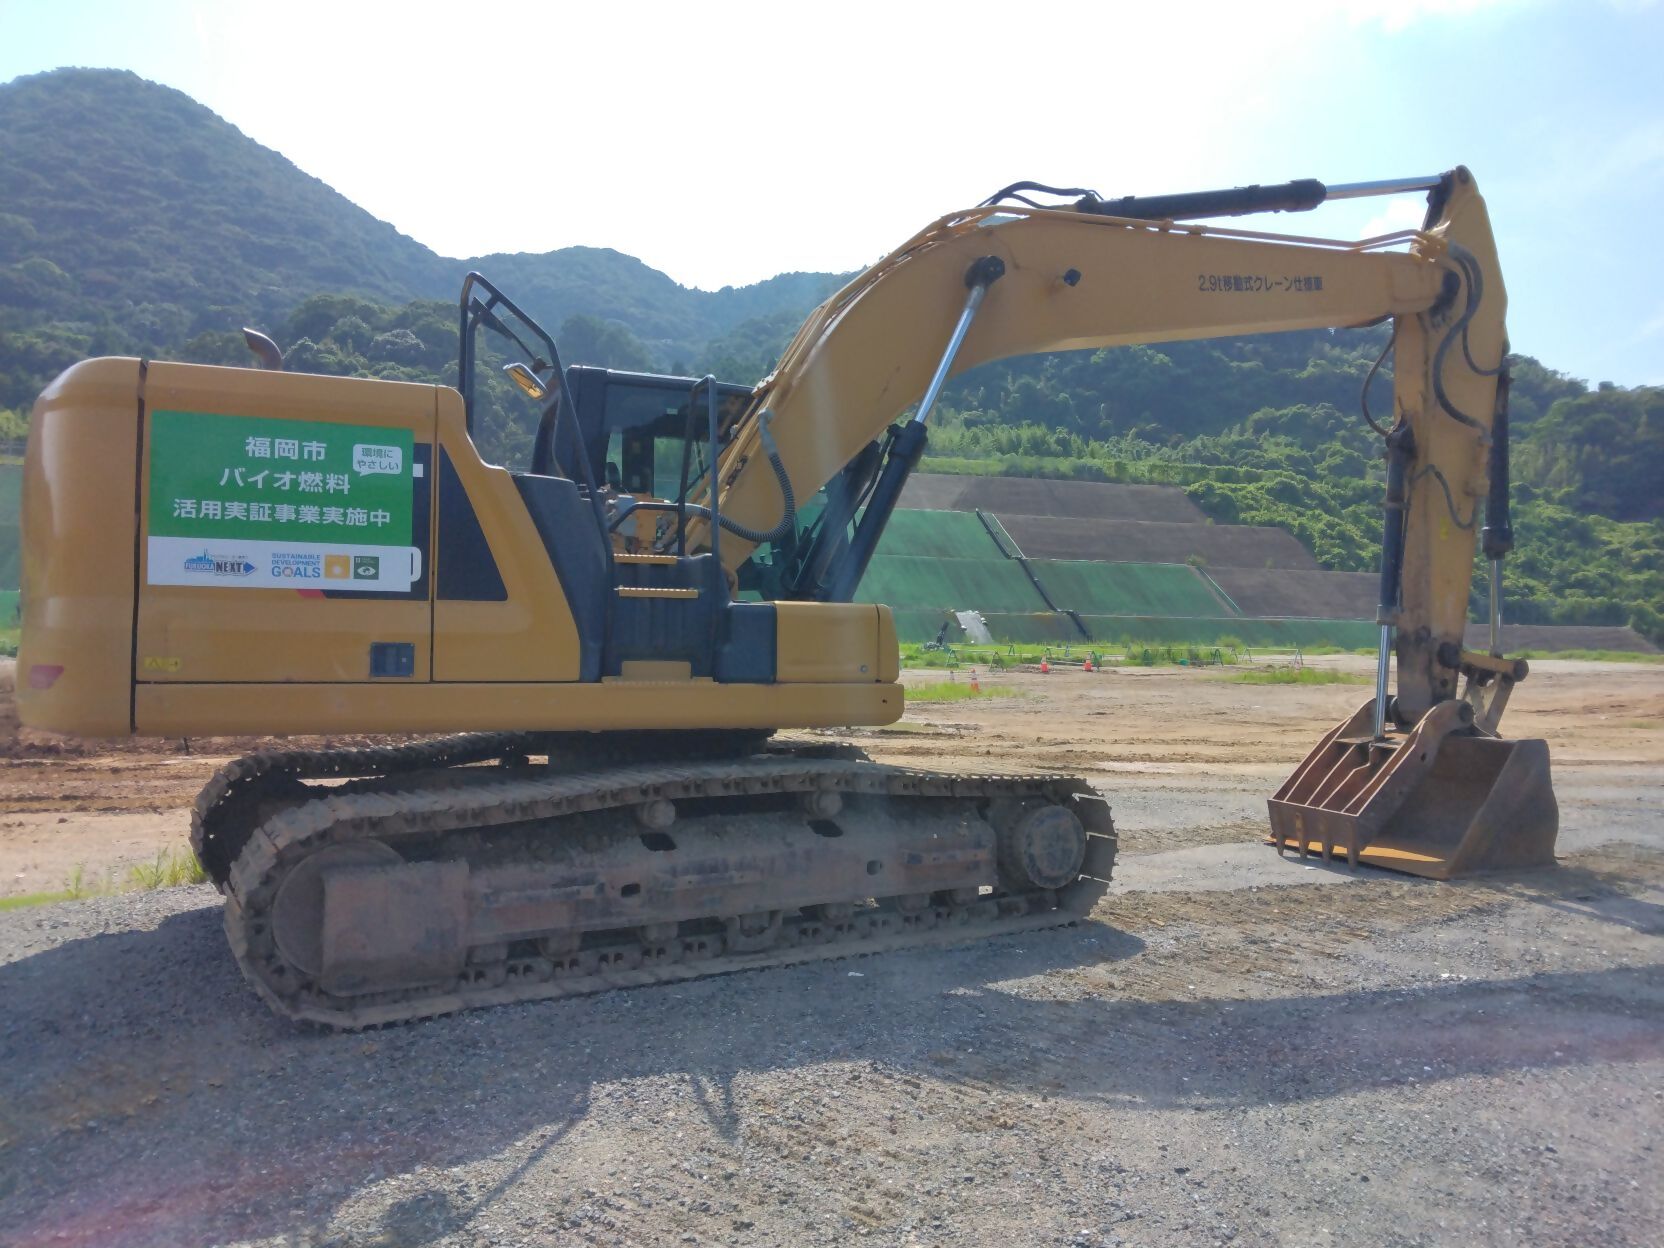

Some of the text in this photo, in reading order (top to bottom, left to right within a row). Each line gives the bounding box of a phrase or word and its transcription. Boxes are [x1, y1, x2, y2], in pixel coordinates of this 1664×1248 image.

[245, 436, 327, 461] 福岡市
[361, 447, 393, 459] 環境に
[357, 460, 399, 470] やさしい
[219, 467, 351, 495] バイオ燃料
[173, 498, 391, 527] 活用実証事業実施中
[271, 552, 321, 561] SUSTAINABLE
[215, 561, 243, 573] NEXT
[271, 559, 321, 567] DEVELOPMENT
[271, 565, 321, 578] GOALS
